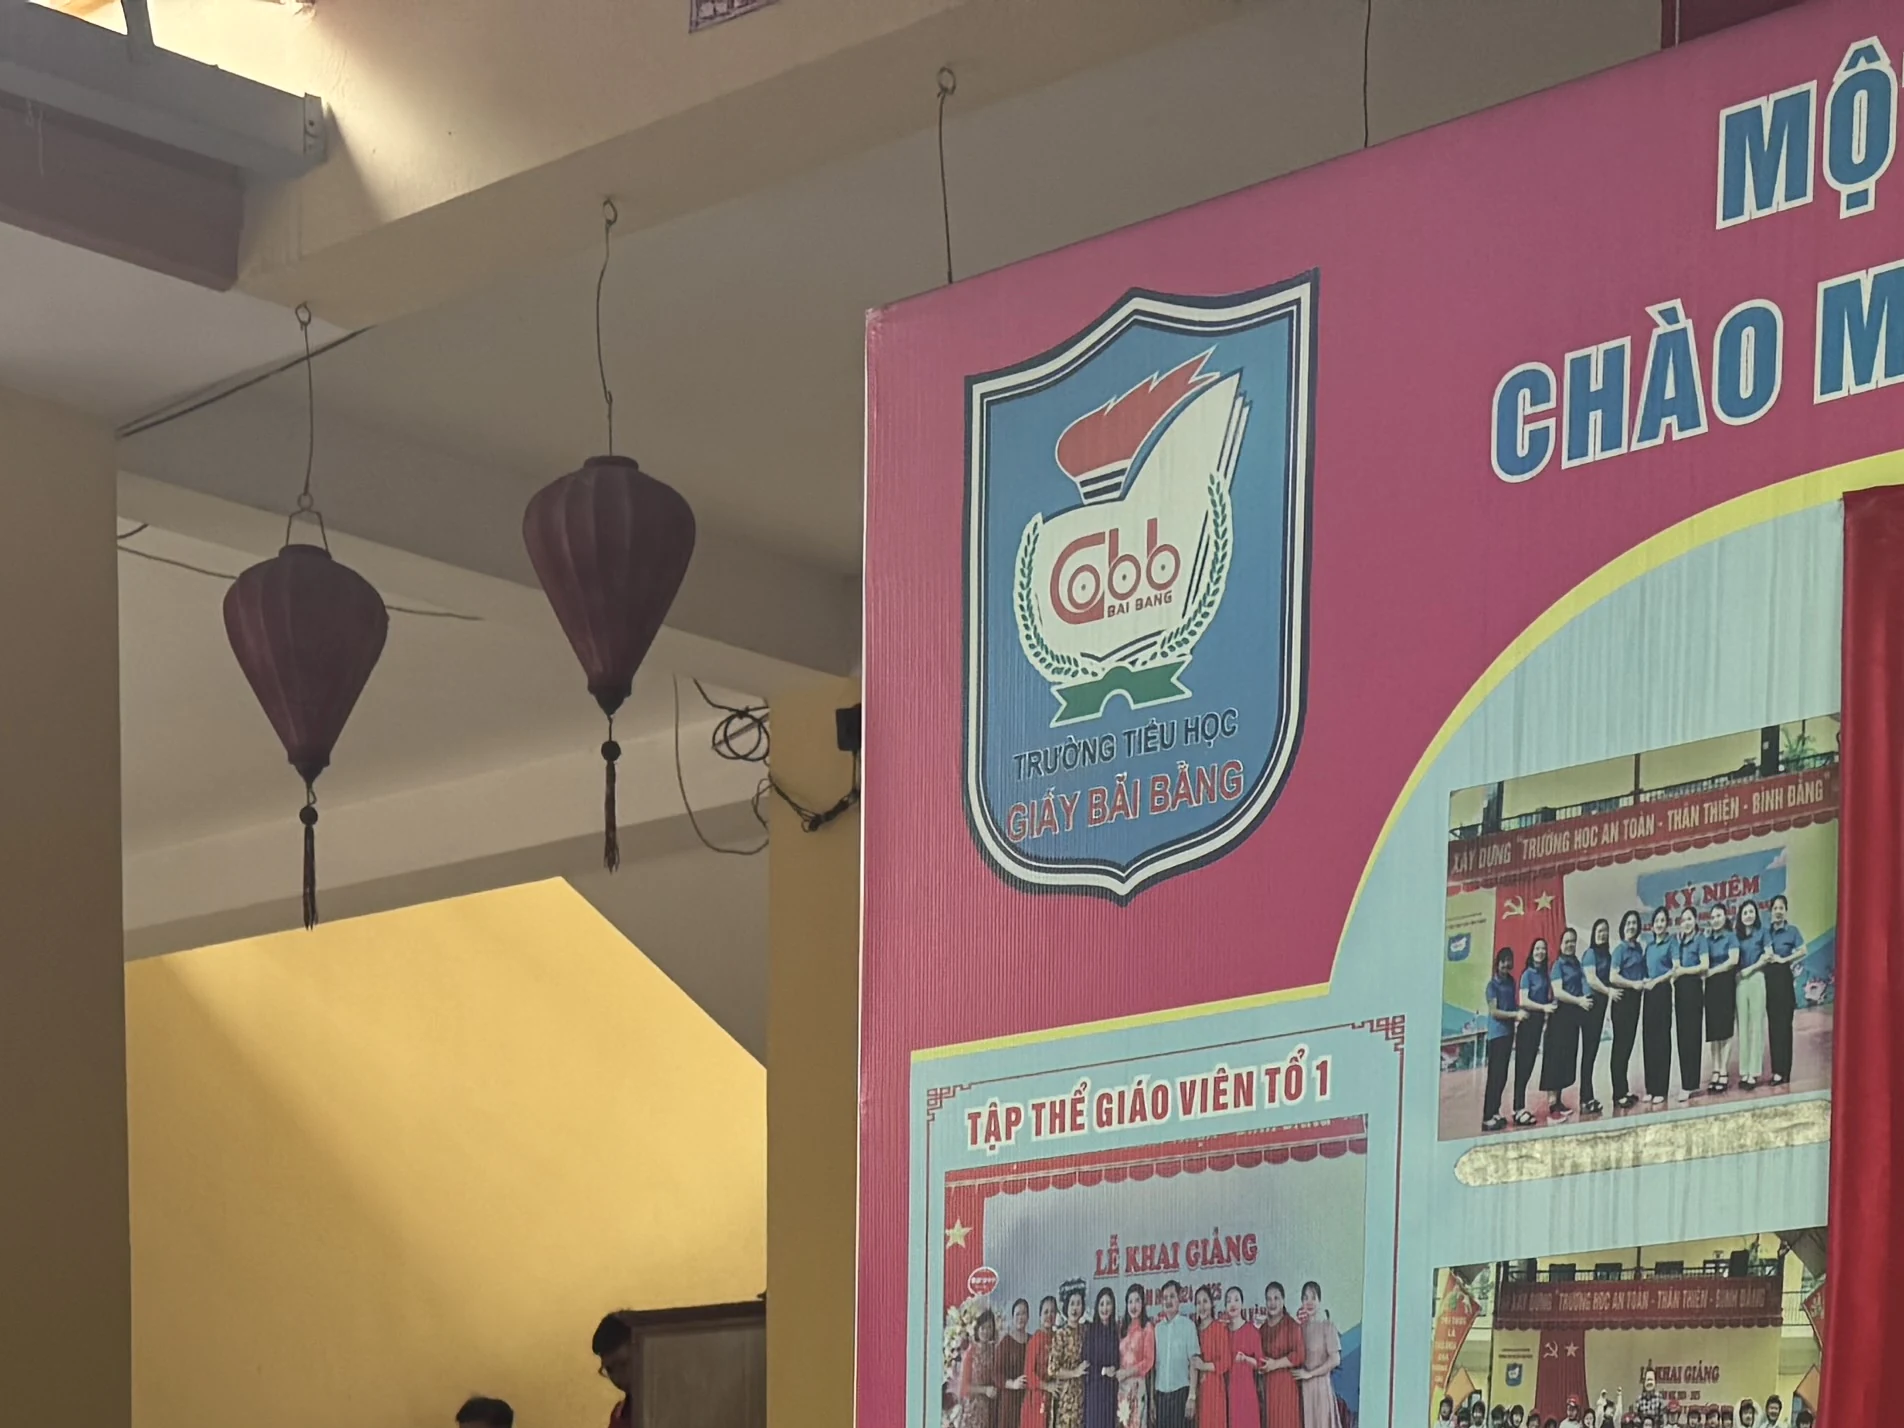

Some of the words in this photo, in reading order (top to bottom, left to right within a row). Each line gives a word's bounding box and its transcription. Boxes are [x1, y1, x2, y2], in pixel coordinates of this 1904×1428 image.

[1488, 297, 1783, 484] CHÀO
[1012, 733, 1118, 783] TRƯỜNG
[1122, 717, 1177, 758] TIỂU
[1183, 708, 1239, 749] HỌC
[1006, 785, 1080, 843] GIẤY
[1087, 771, 1141, 827] BÃI
[1149, 759, 1245, 815] BẰNG
[1574, 827, 1598, 853] HỌC
[1601, 821, 1619, 846] AN
[1623, 811, 1655, 841] TOÀN
[1703, 794, 1740, 825] THIỆN
[968, 1102, 1022, 1151] TẬP
[1031, 1080, 1087, 1137] THỂ
[1096, 1079, 1169, 1128] GIÁO
[1179, 1067, 1254, 1116] VIÊN
[1265, 1047, 1306, 1104] TỔ
[1315, 1060, 1329, 1097] 1
[1094, 1233, 1120, 1279] LỄ
[1125, 1242, 1181, 1275] KHAI
[1186, 1226, 1259, 1270] GIẢNG
